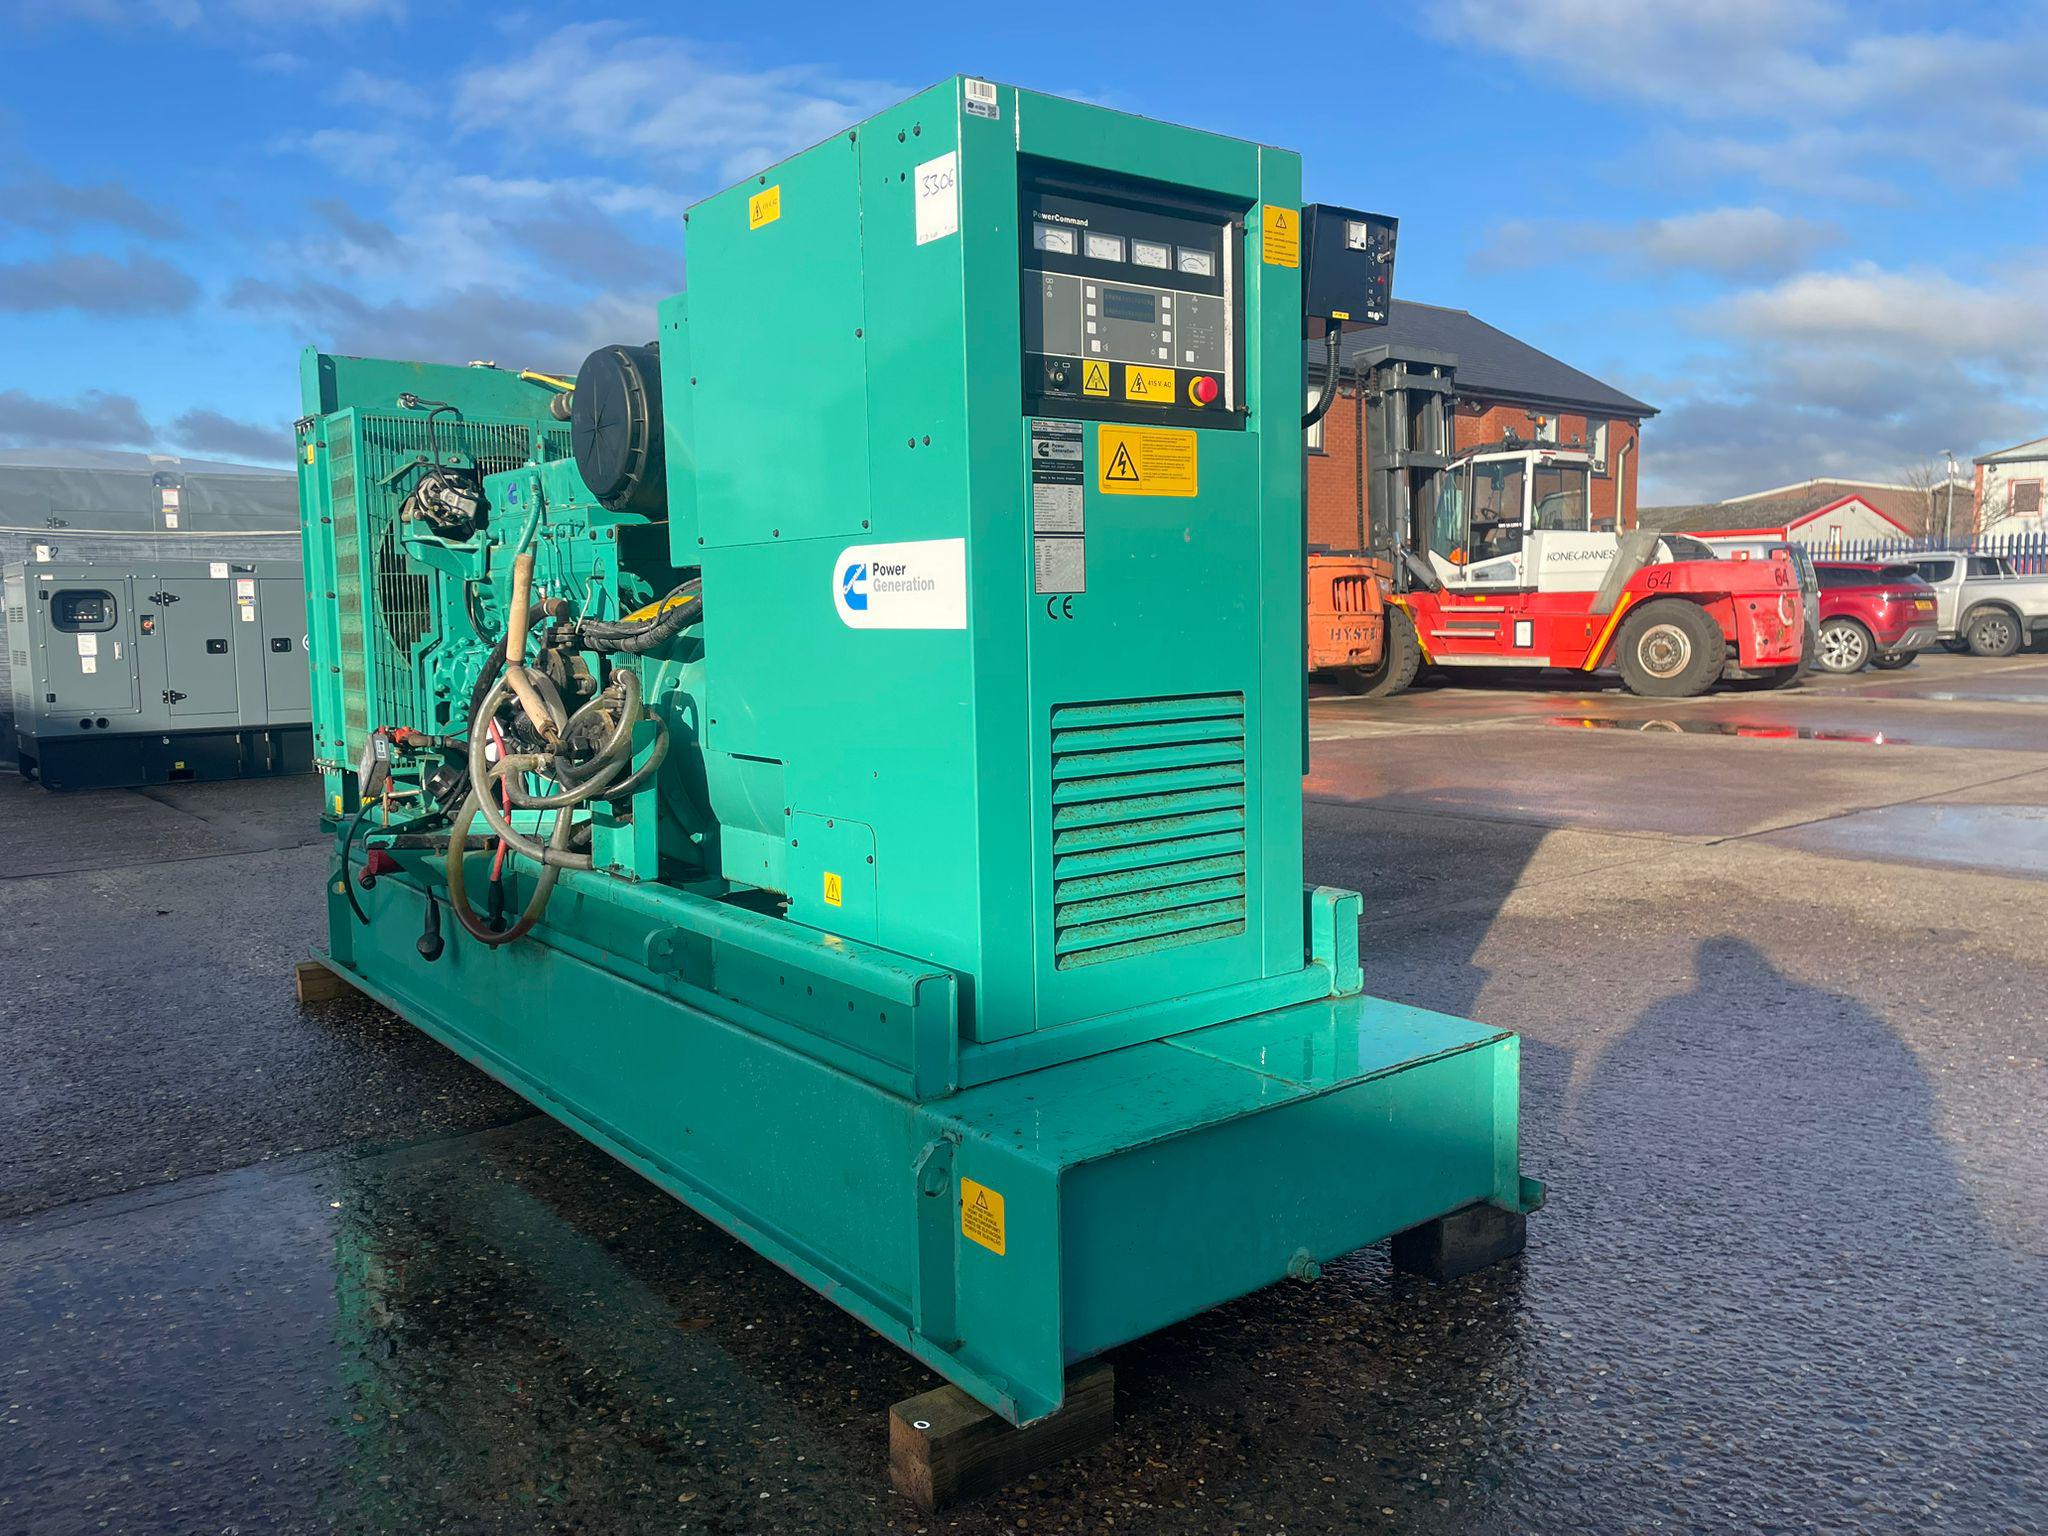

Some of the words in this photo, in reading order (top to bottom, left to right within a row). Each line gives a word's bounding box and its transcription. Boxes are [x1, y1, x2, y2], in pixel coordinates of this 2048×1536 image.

[1032, 210, 1089, 227] PowerCommand
[1546, 550, 1615, 562] KONECRANES
[872, 562, 907, 576] Power
[1775, 568, 1788, 586] 64
[873, 576, 935, 592] Generation
[1646, 570, 1673, 589] 64
